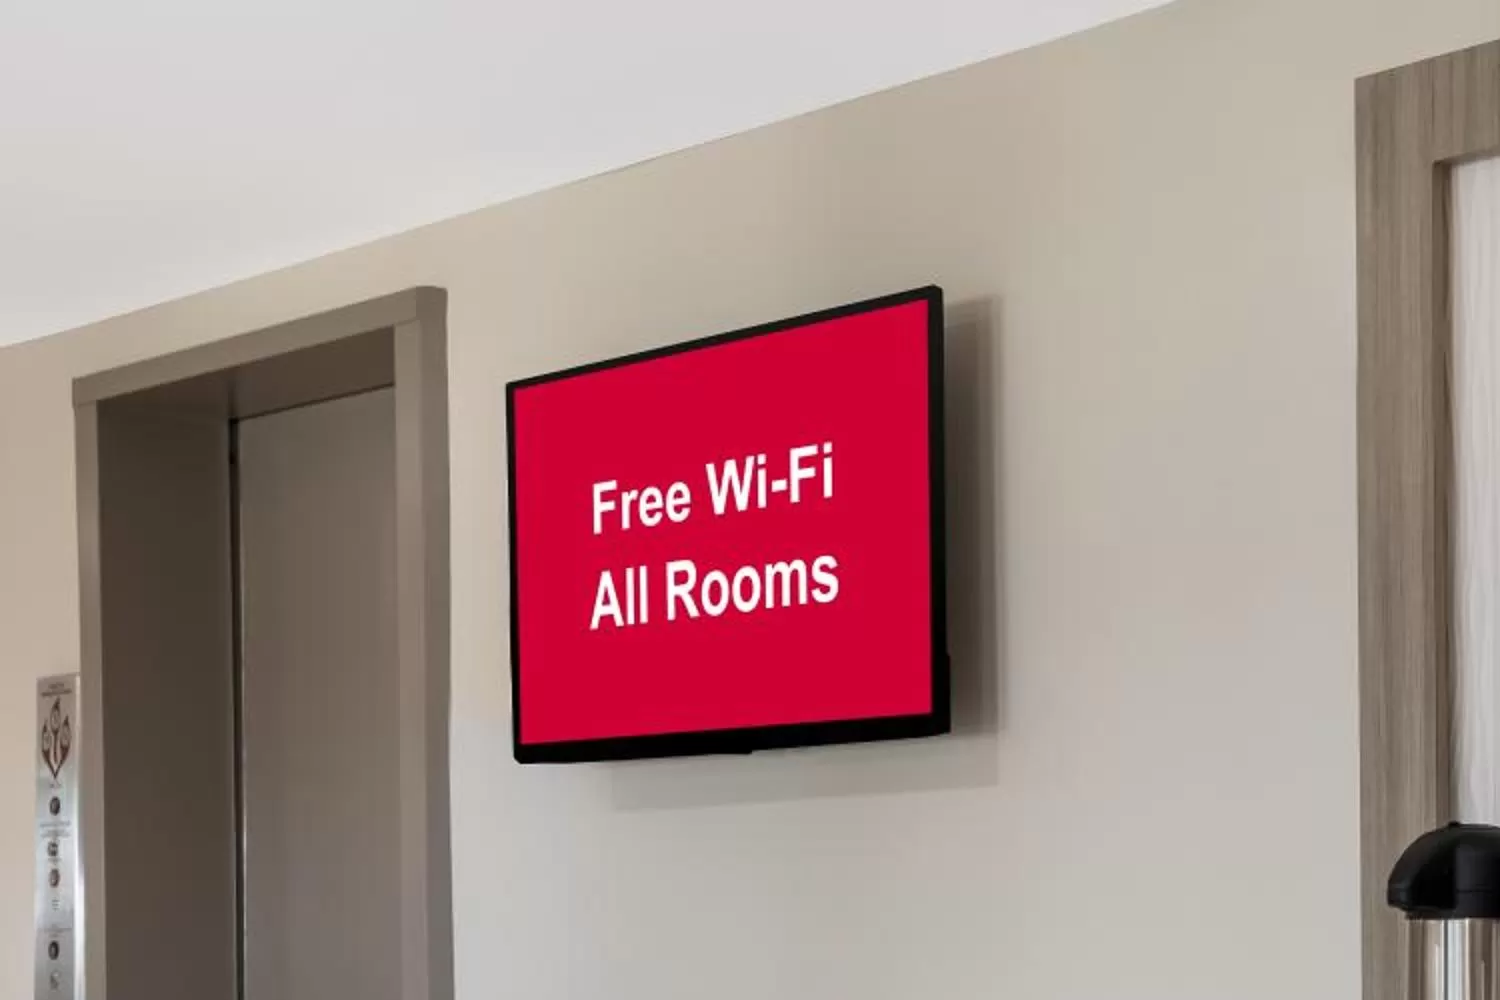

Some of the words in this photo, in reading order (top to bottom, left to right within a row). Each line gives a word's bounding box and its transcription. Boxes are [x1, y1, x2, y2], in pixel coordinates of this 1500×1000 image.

[592, 480, 691, 535] Free
[706, 442, 833, 515] Wi-Fi
[590, 565, 649, 630] All
[666, 555, 839, 621] Rooms
